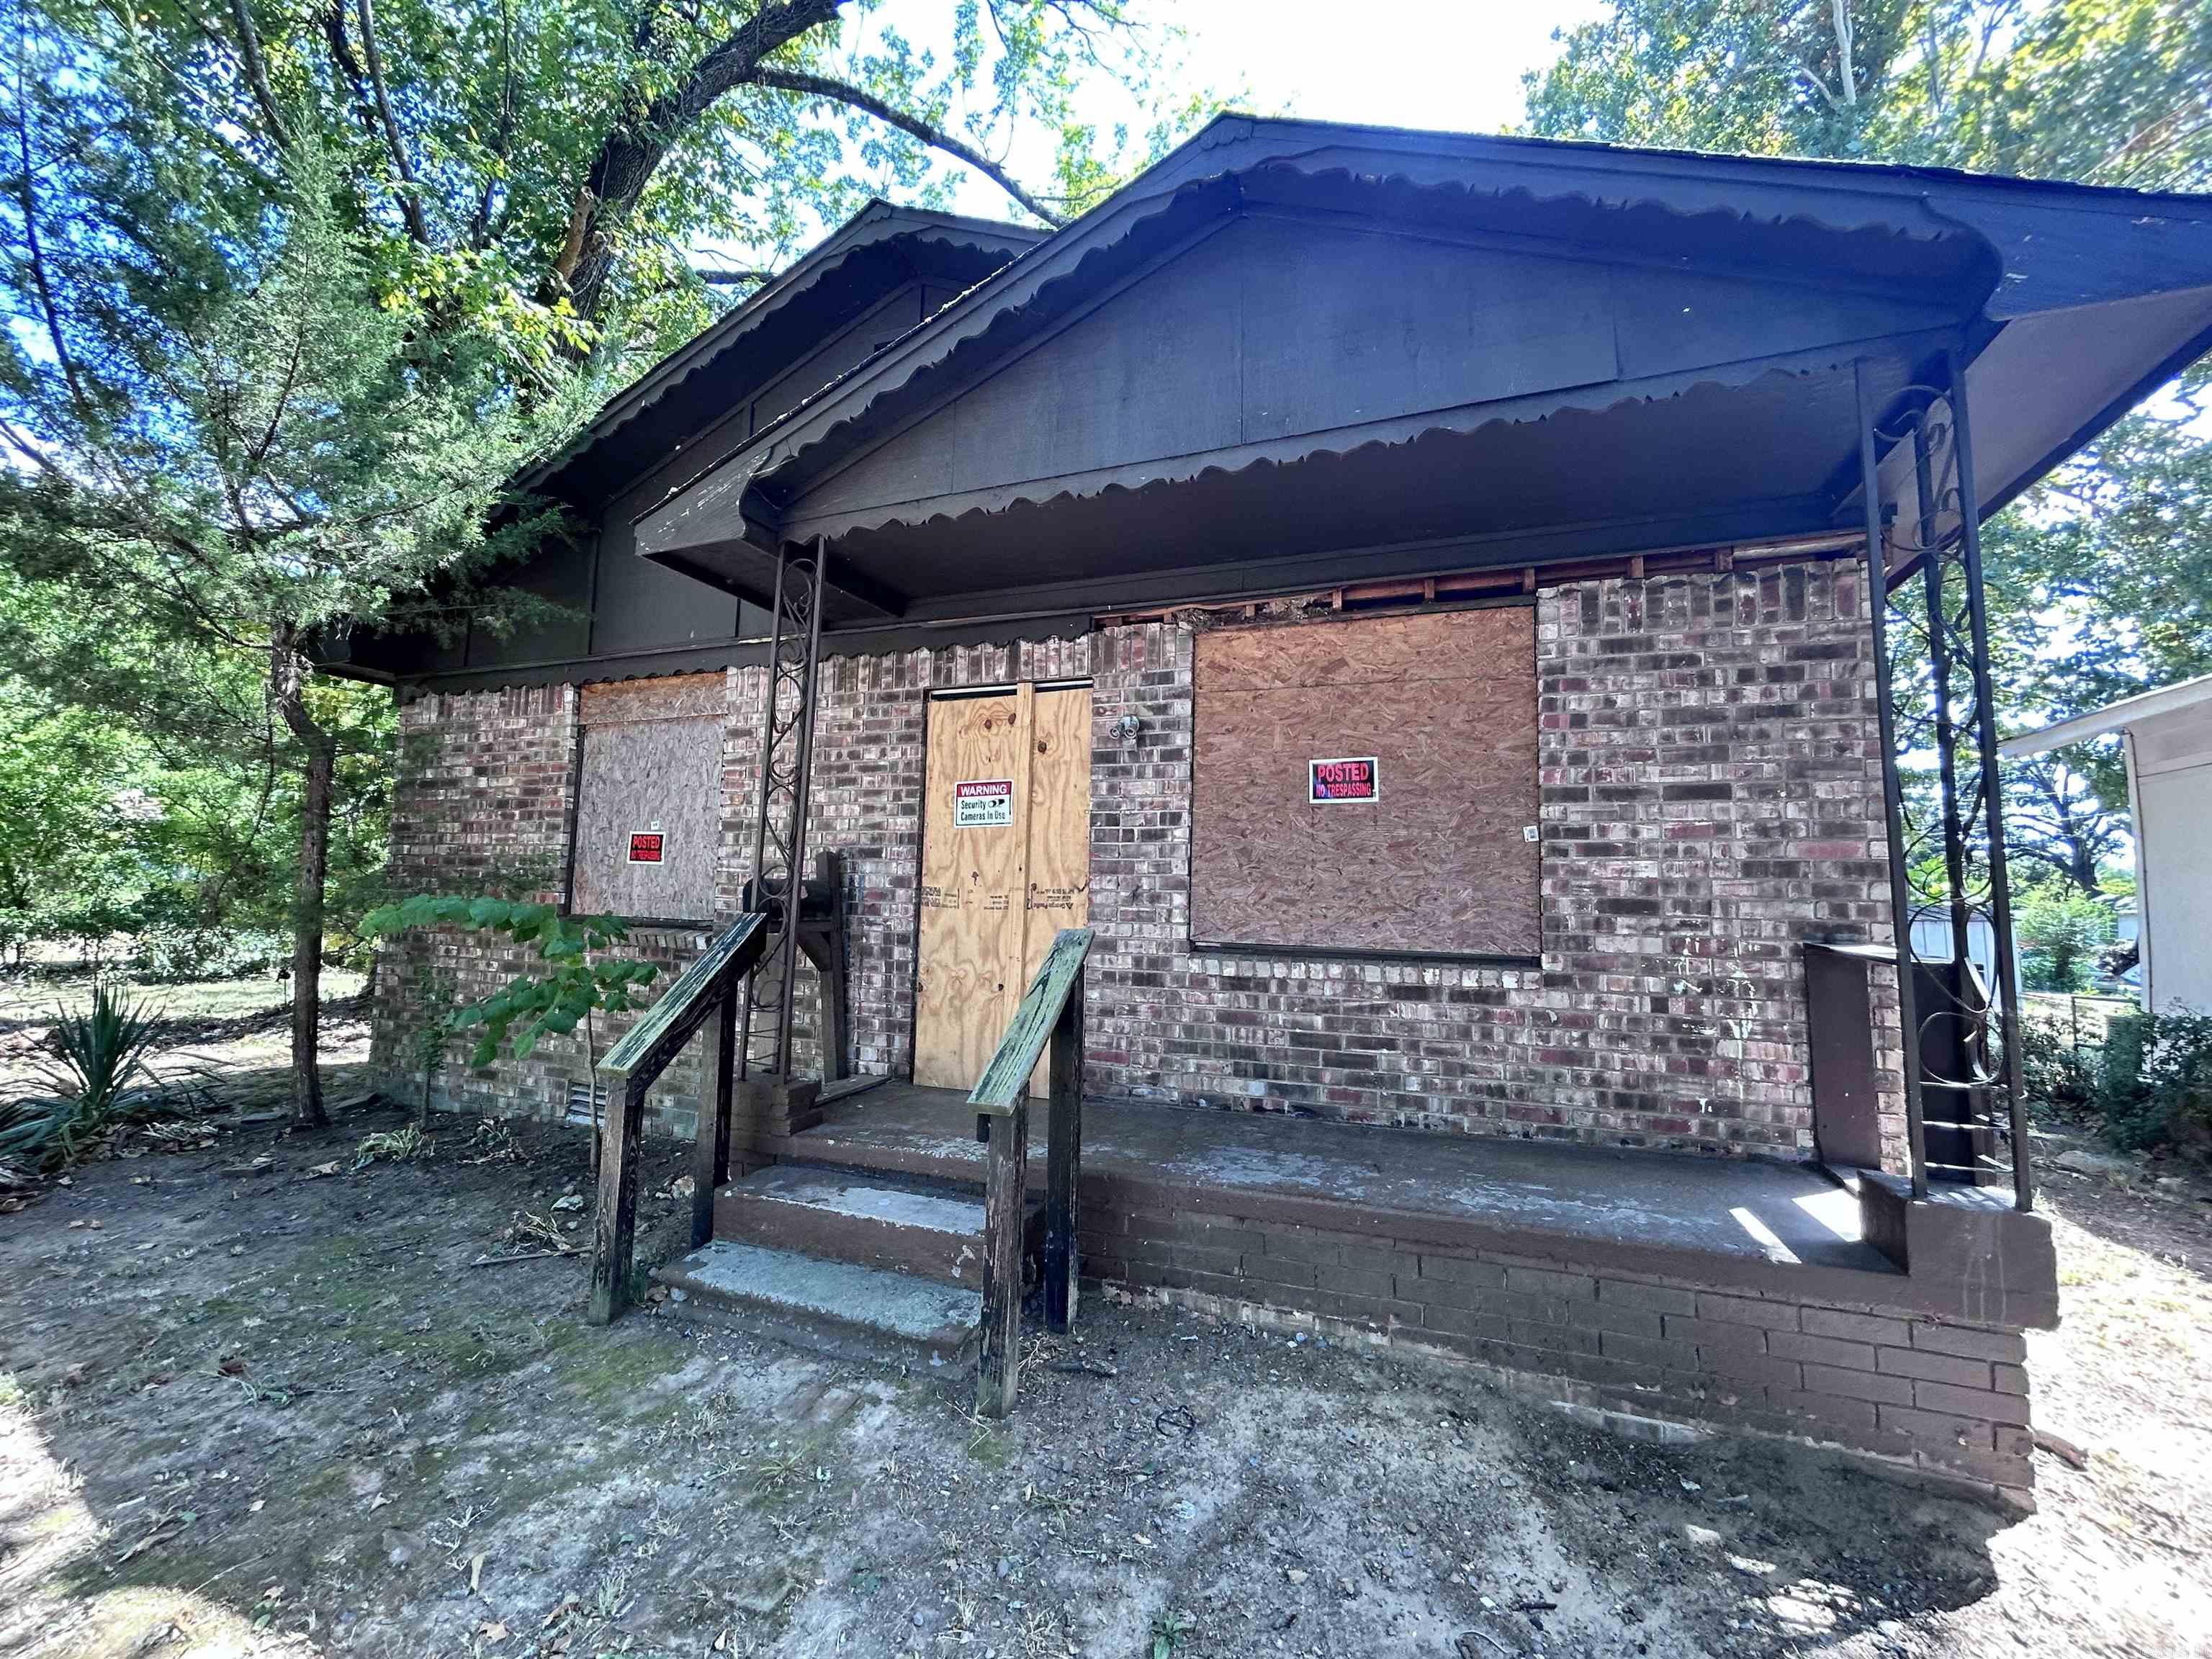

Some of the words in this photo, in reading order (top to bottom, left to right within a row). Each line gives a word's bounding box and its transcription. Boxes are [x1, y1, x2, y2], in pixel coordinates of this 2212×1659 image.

[1317, 763, 1369, 783] POSTED
[960, 784, 1007, 796] WARNING
[1316, 783, 1326, 797] NO
[1327, 782, 1372, 797] TRESPASSING
[961, 799, 986, 810] Security
[961, 811, 986, 821] Cameras
[987, 811, 994, 819] In
[994, 810, 1006, 819] Use
[633, 835, 660, 849] POSTED
